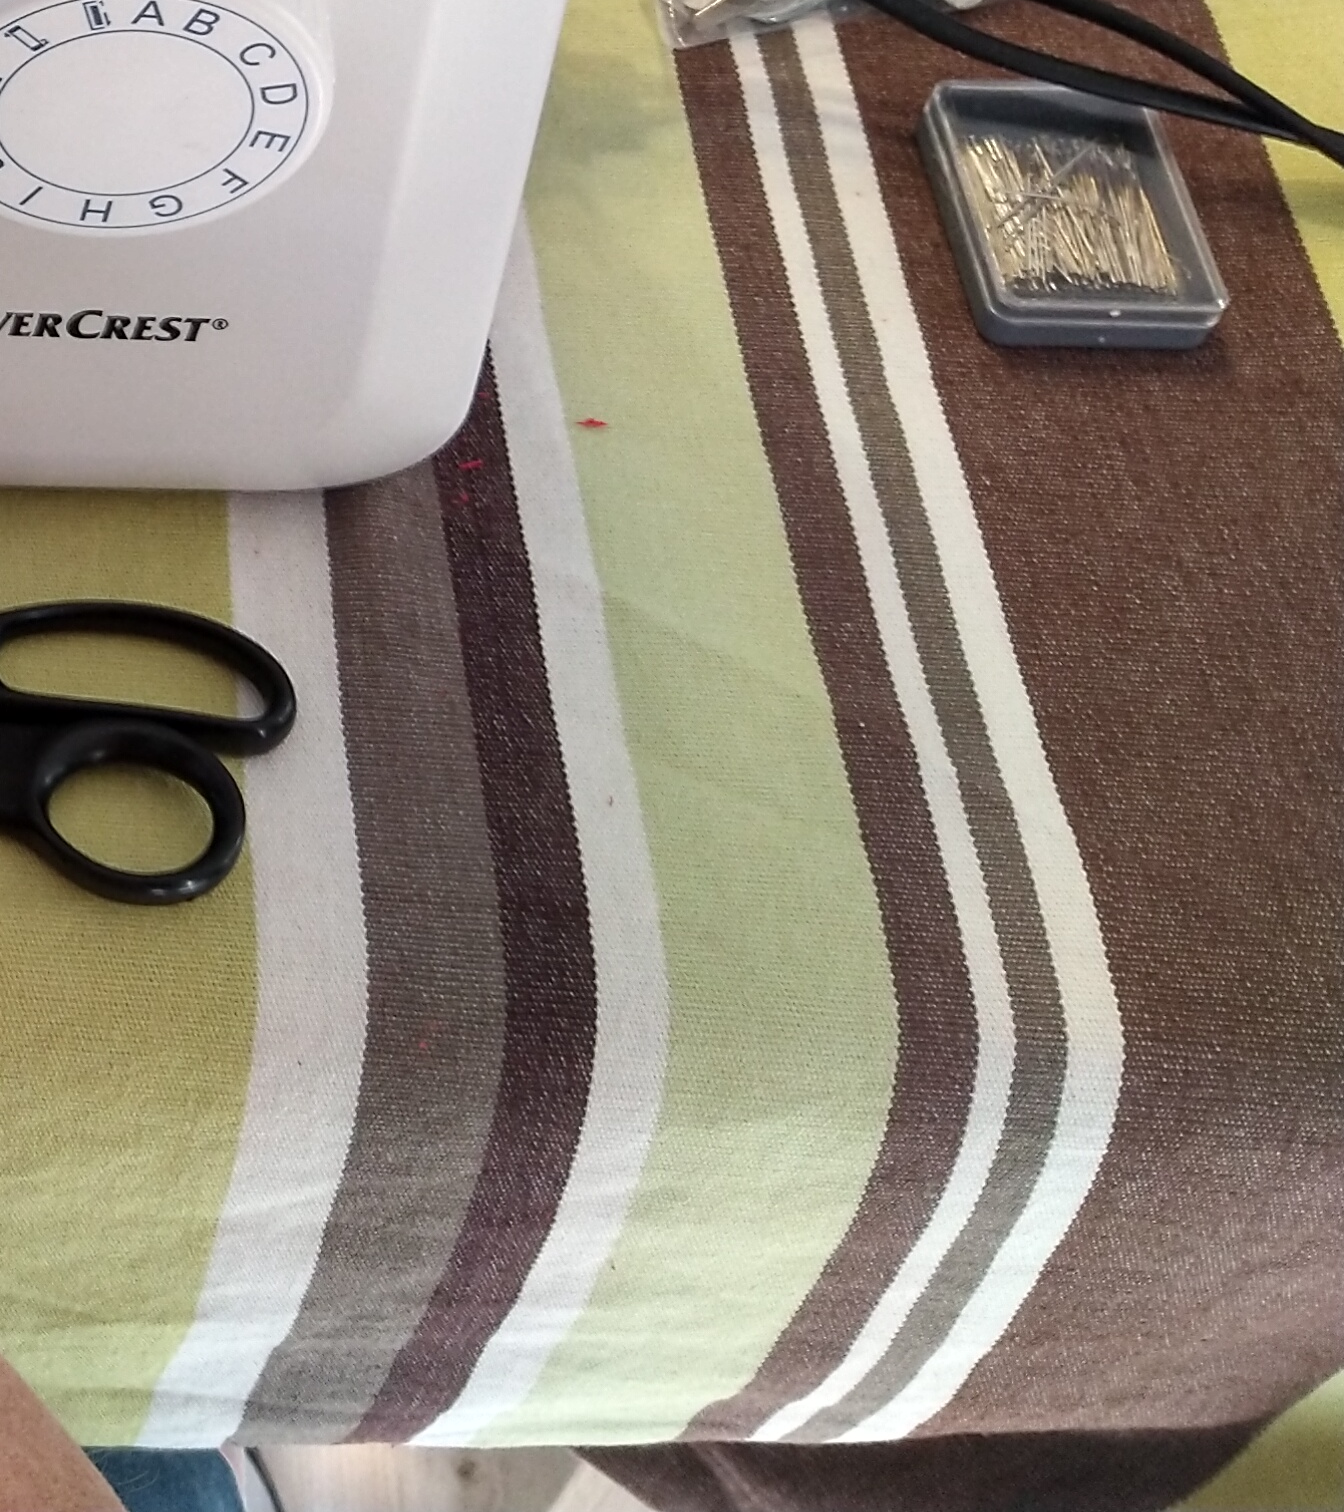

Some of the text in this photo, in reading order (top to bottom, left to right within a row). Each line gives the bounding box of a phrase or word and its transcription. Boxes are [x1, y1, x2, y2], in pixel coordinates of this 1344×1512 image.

[130, 0, 165, 27] A
[182, 8, 221, 36] B
[238, 43, 277, 66] C
[259, 82, 298, 106] D
[248, 130, 291, 153] E
[221, 168, 250, 194] F
[18, 186, 44, 206] I
[148, 194, 184, 217] G
[79, 198, 113, 223] H
